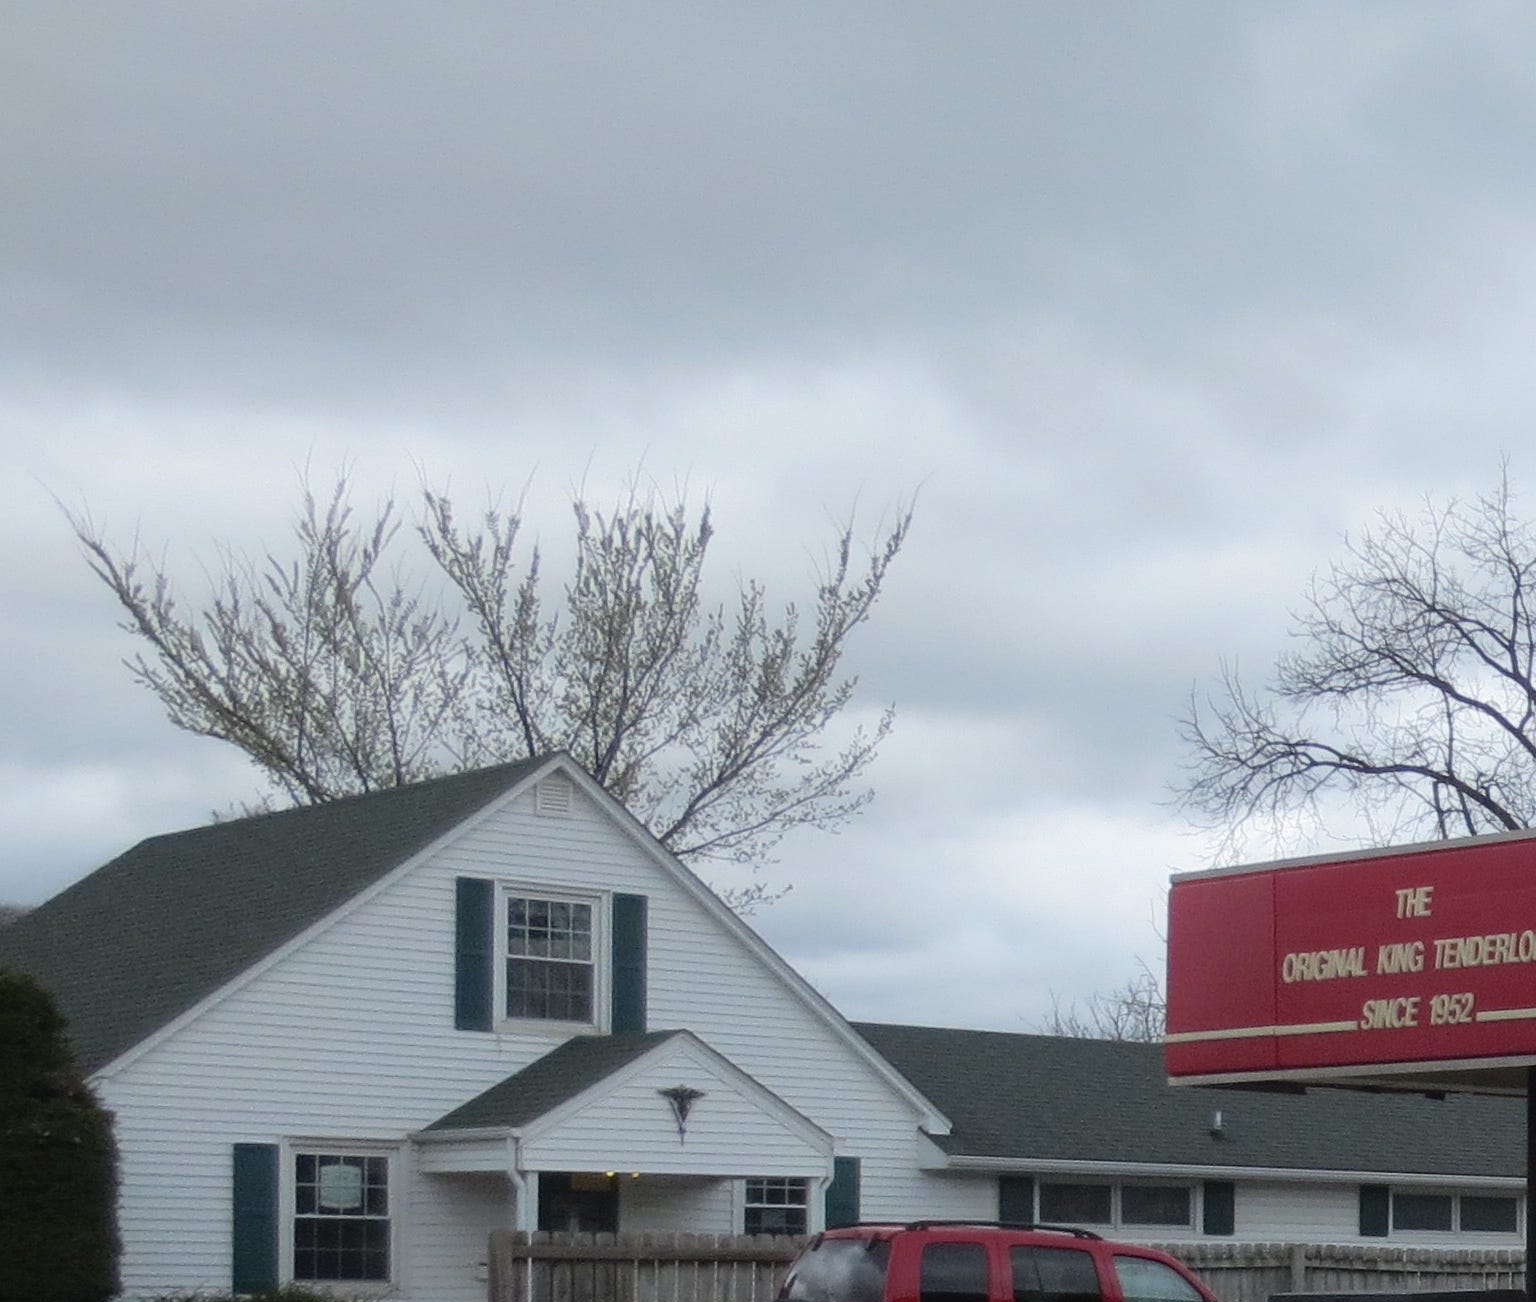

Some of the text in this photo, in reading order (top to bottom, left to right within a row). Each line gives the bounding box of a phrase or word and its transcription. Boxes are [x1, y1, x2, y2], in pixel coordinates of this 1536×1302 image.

[1395, 886, 1434, 919] THE
[1282, 947, 1368, 984] ORIGINAL
[1376, 940, 1424, 975] KING
[1361, 993, 1474, 1030] SINCE 1952
